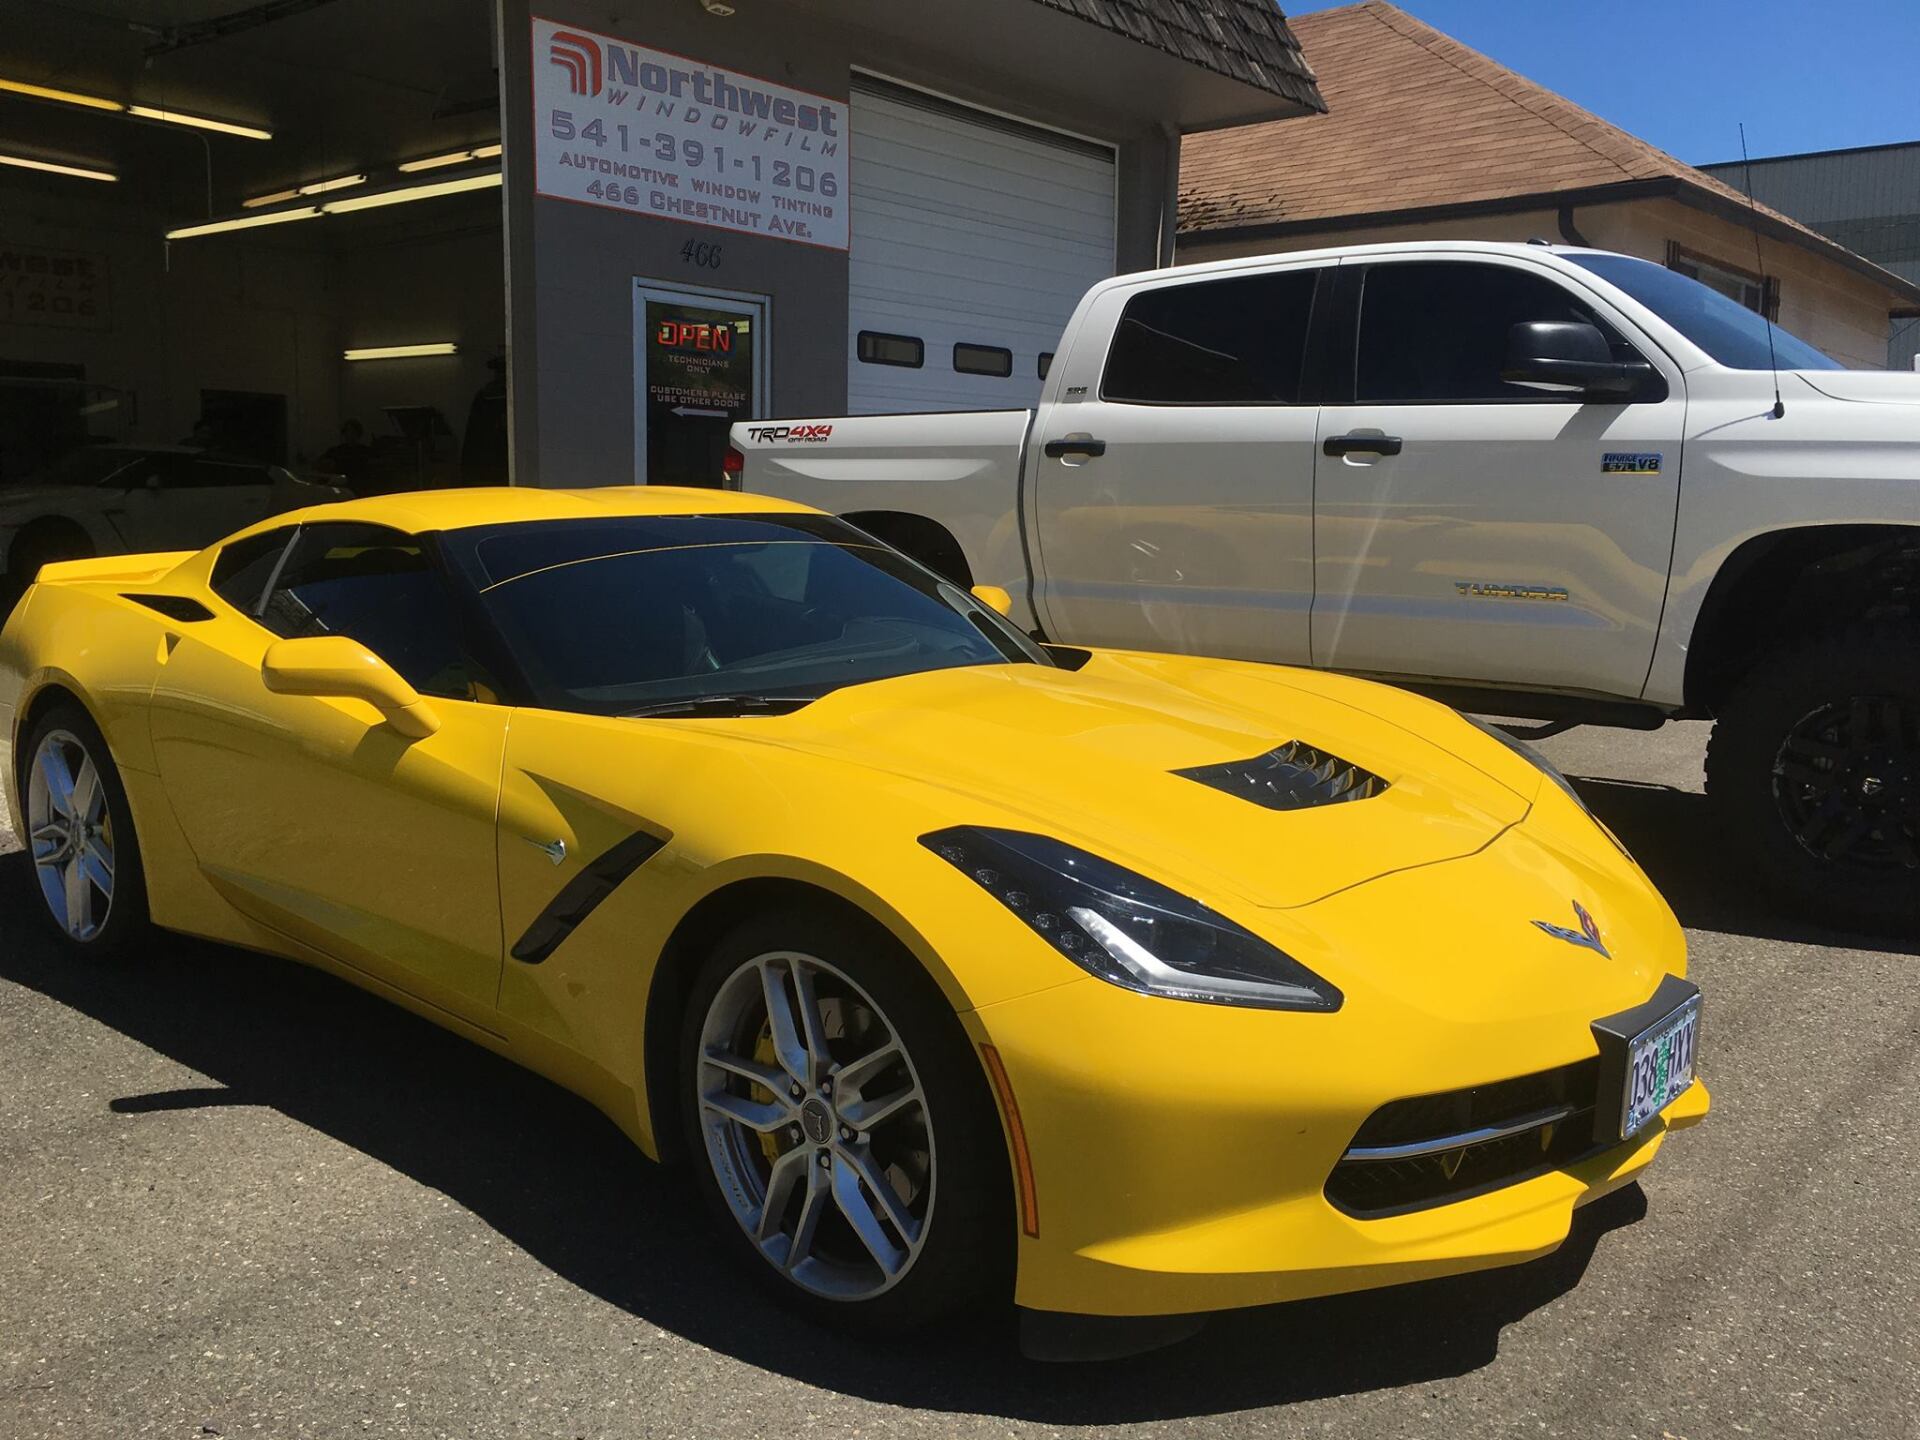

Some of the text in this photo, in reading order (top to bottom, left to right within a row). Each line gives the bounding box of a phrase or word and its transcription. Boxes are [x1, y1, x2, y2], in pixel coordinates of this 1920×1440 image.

[607, 44, 838, 137] Northwest
[607, 88, 838, 157] WINDOWFILM
[551, 110, 838, 198] 541-391-1206
[559, 151, 833, 219] AUTOMOTIVE WINDOW TINTING
[586, 179, 813, 239] 466 CHESTNUT AVE.
[680, 239, 721, 269] 466
[657, 321, 730, 353] OPEN
[668, 354, 729, 369] TECHNICIANS
[687, 364, 711, 375] ONLY
[650, 385, 746, 401] CUSTOMERS PLEASE
[657, 394, 739, 408] USE OTHER DOOR
[748, 426, 790, 443] TRD
[1638, 458, 1659, 470] V8
[1455, 582, 1569, 601] TUNDRA
